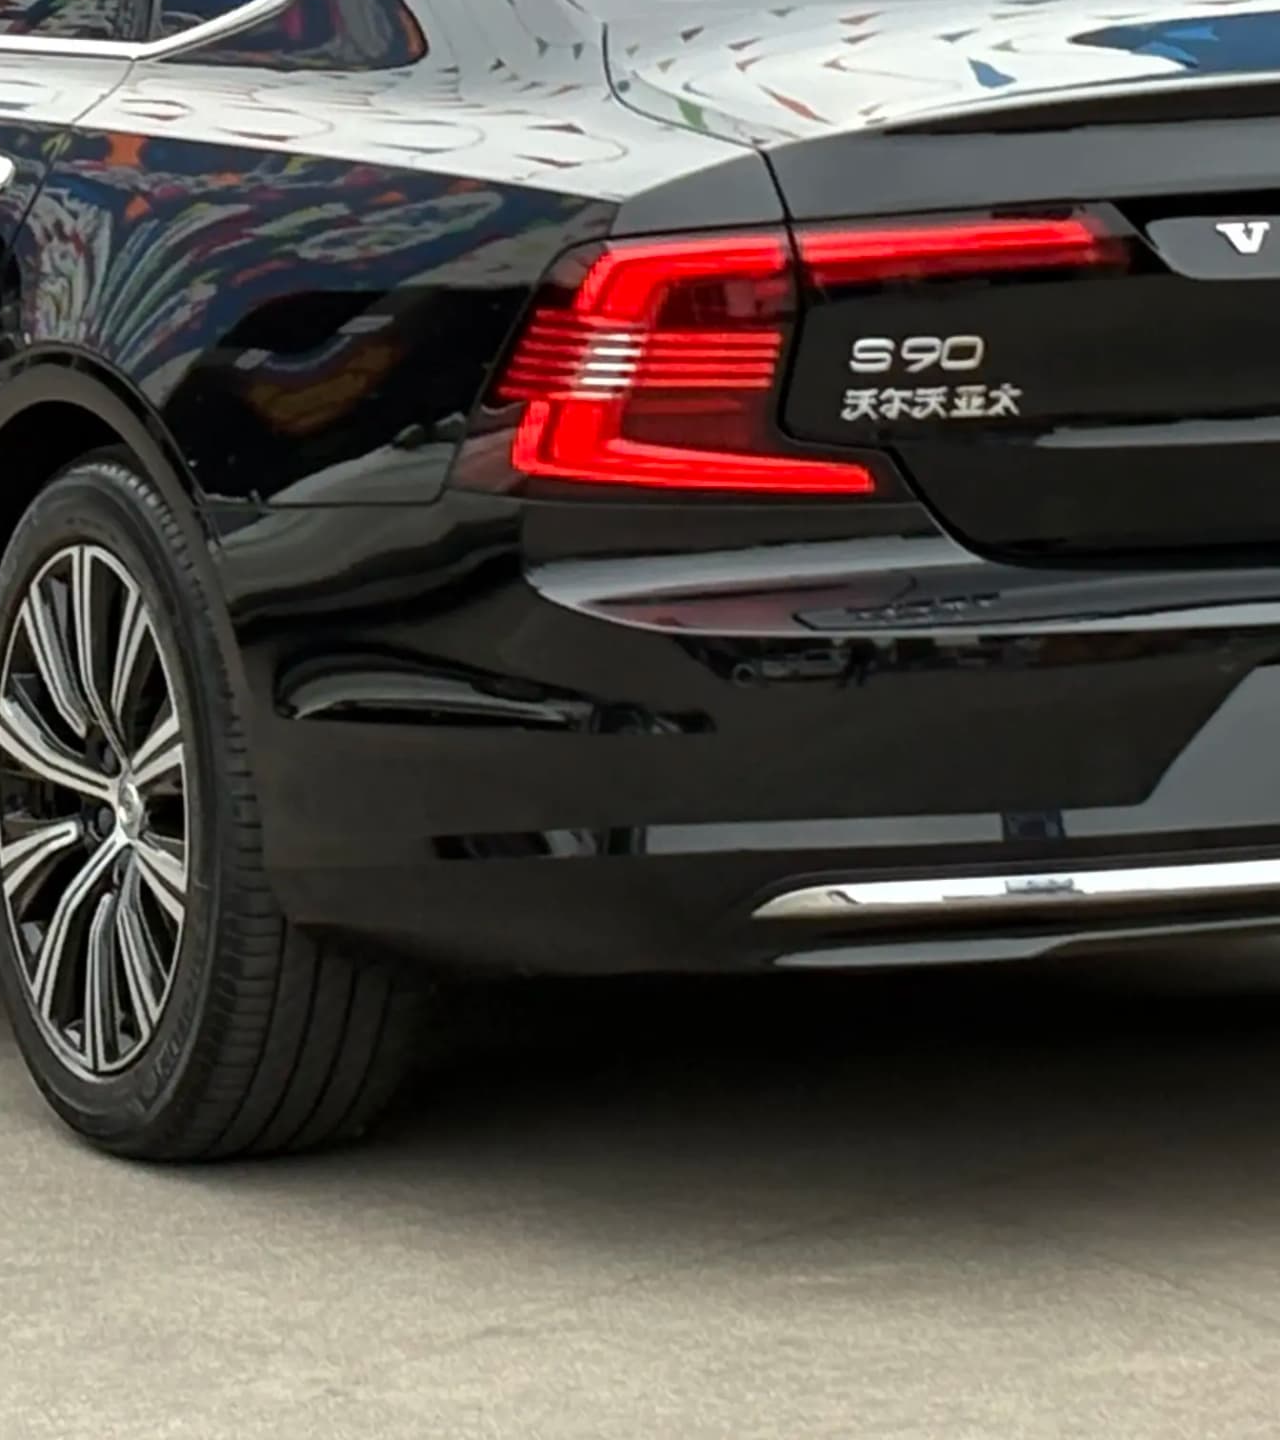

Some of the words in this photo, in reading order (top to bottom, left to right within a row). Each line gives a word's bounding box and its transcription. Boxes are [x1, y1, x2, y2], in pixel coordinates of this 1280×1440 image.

[849, 334, 984, 373] S90
[840, 382, 1023, 421] 沃尔沃亚太
